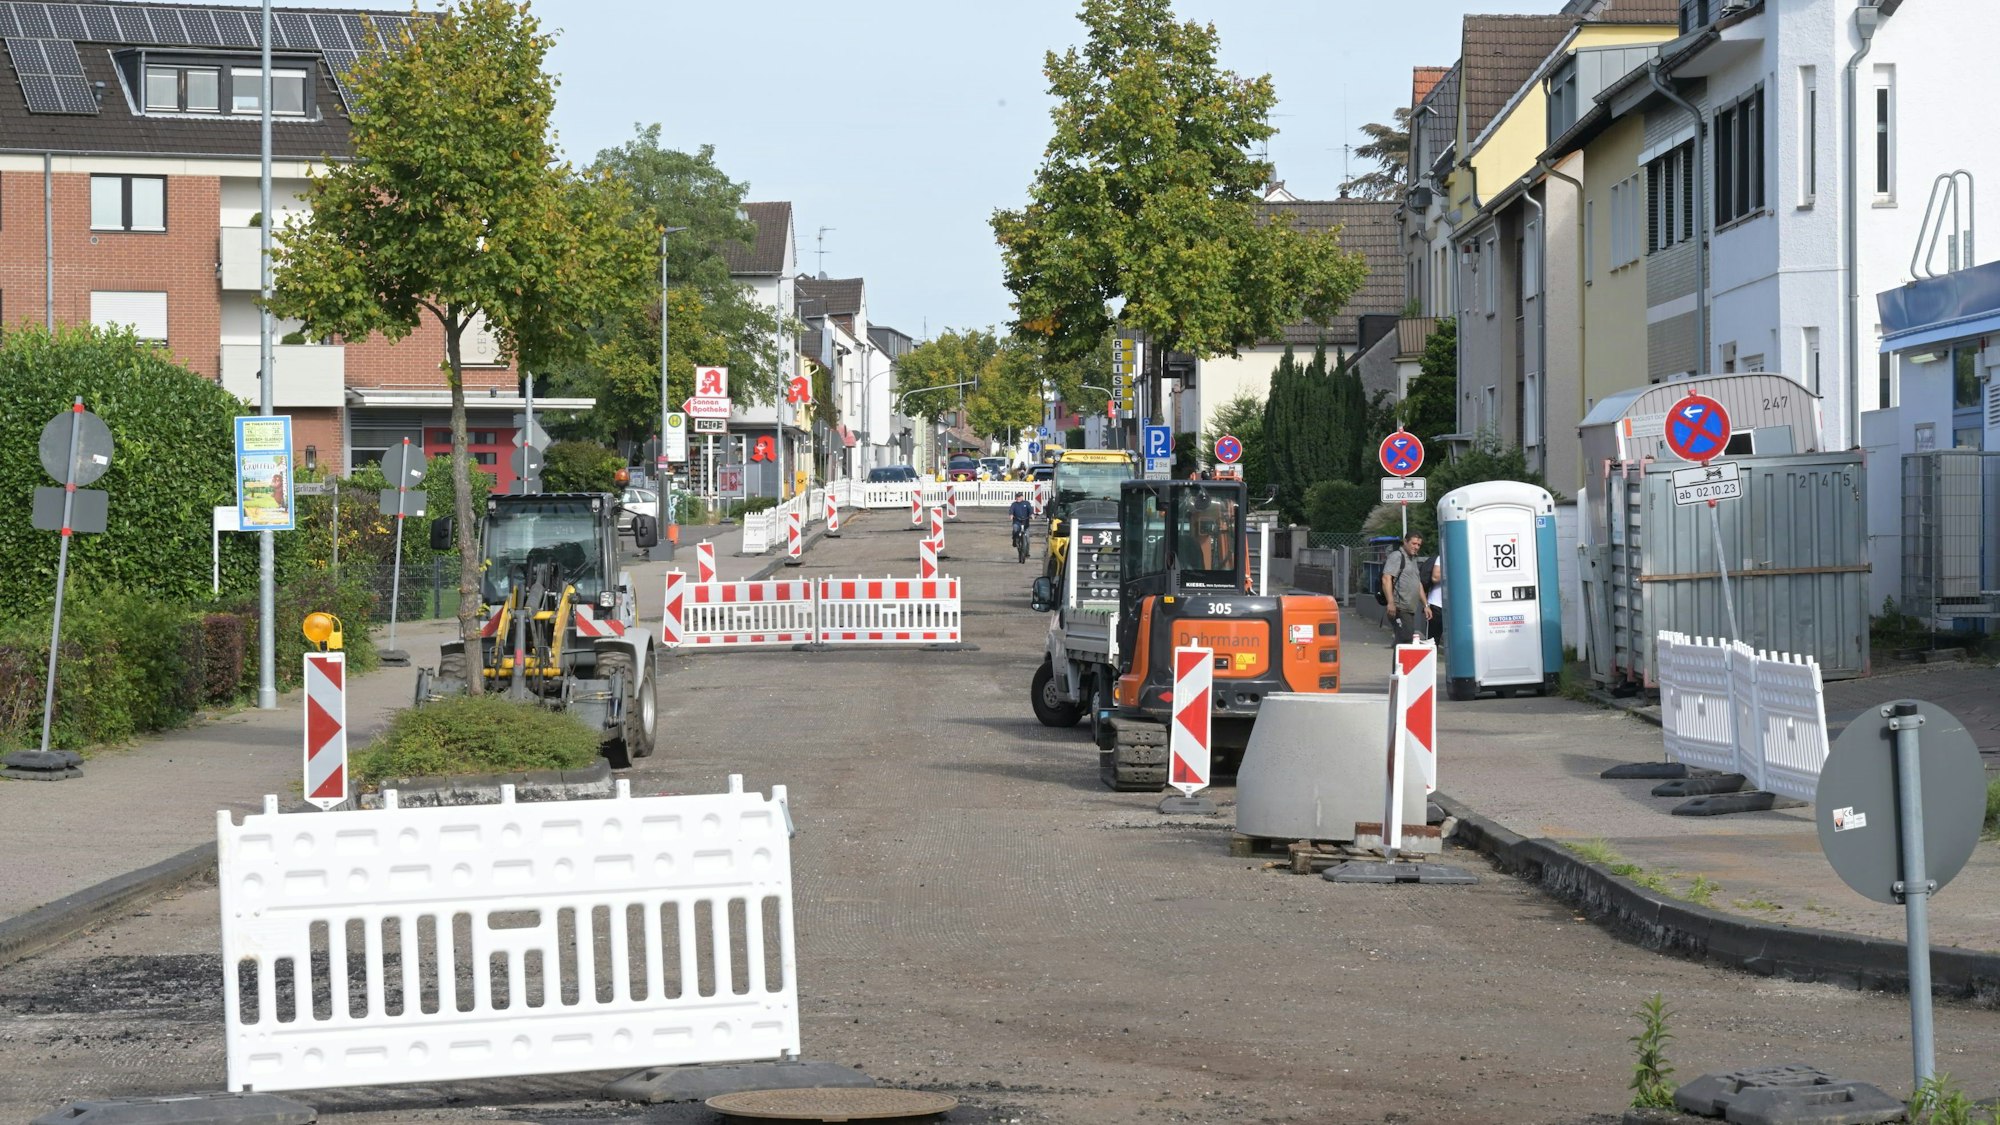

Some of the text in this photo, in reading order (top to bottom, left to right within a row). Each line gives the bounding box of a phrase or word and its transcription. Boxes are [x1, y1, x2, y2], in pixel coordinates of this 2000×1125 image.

[1114, 340, 1122, 409] REISEN
[1763, 396, 1788, 410] 247
[1151, 430, 1165, 455] P
[1397, 491, 1423, 499] 02.10.23
[1680, 483, 1736, 500] ab 02.10.23
[1493, 543, 1516, 556] TOI
[1493, 556, 1517, 569] TOI
[1208, 602, 1232, 614] 305
